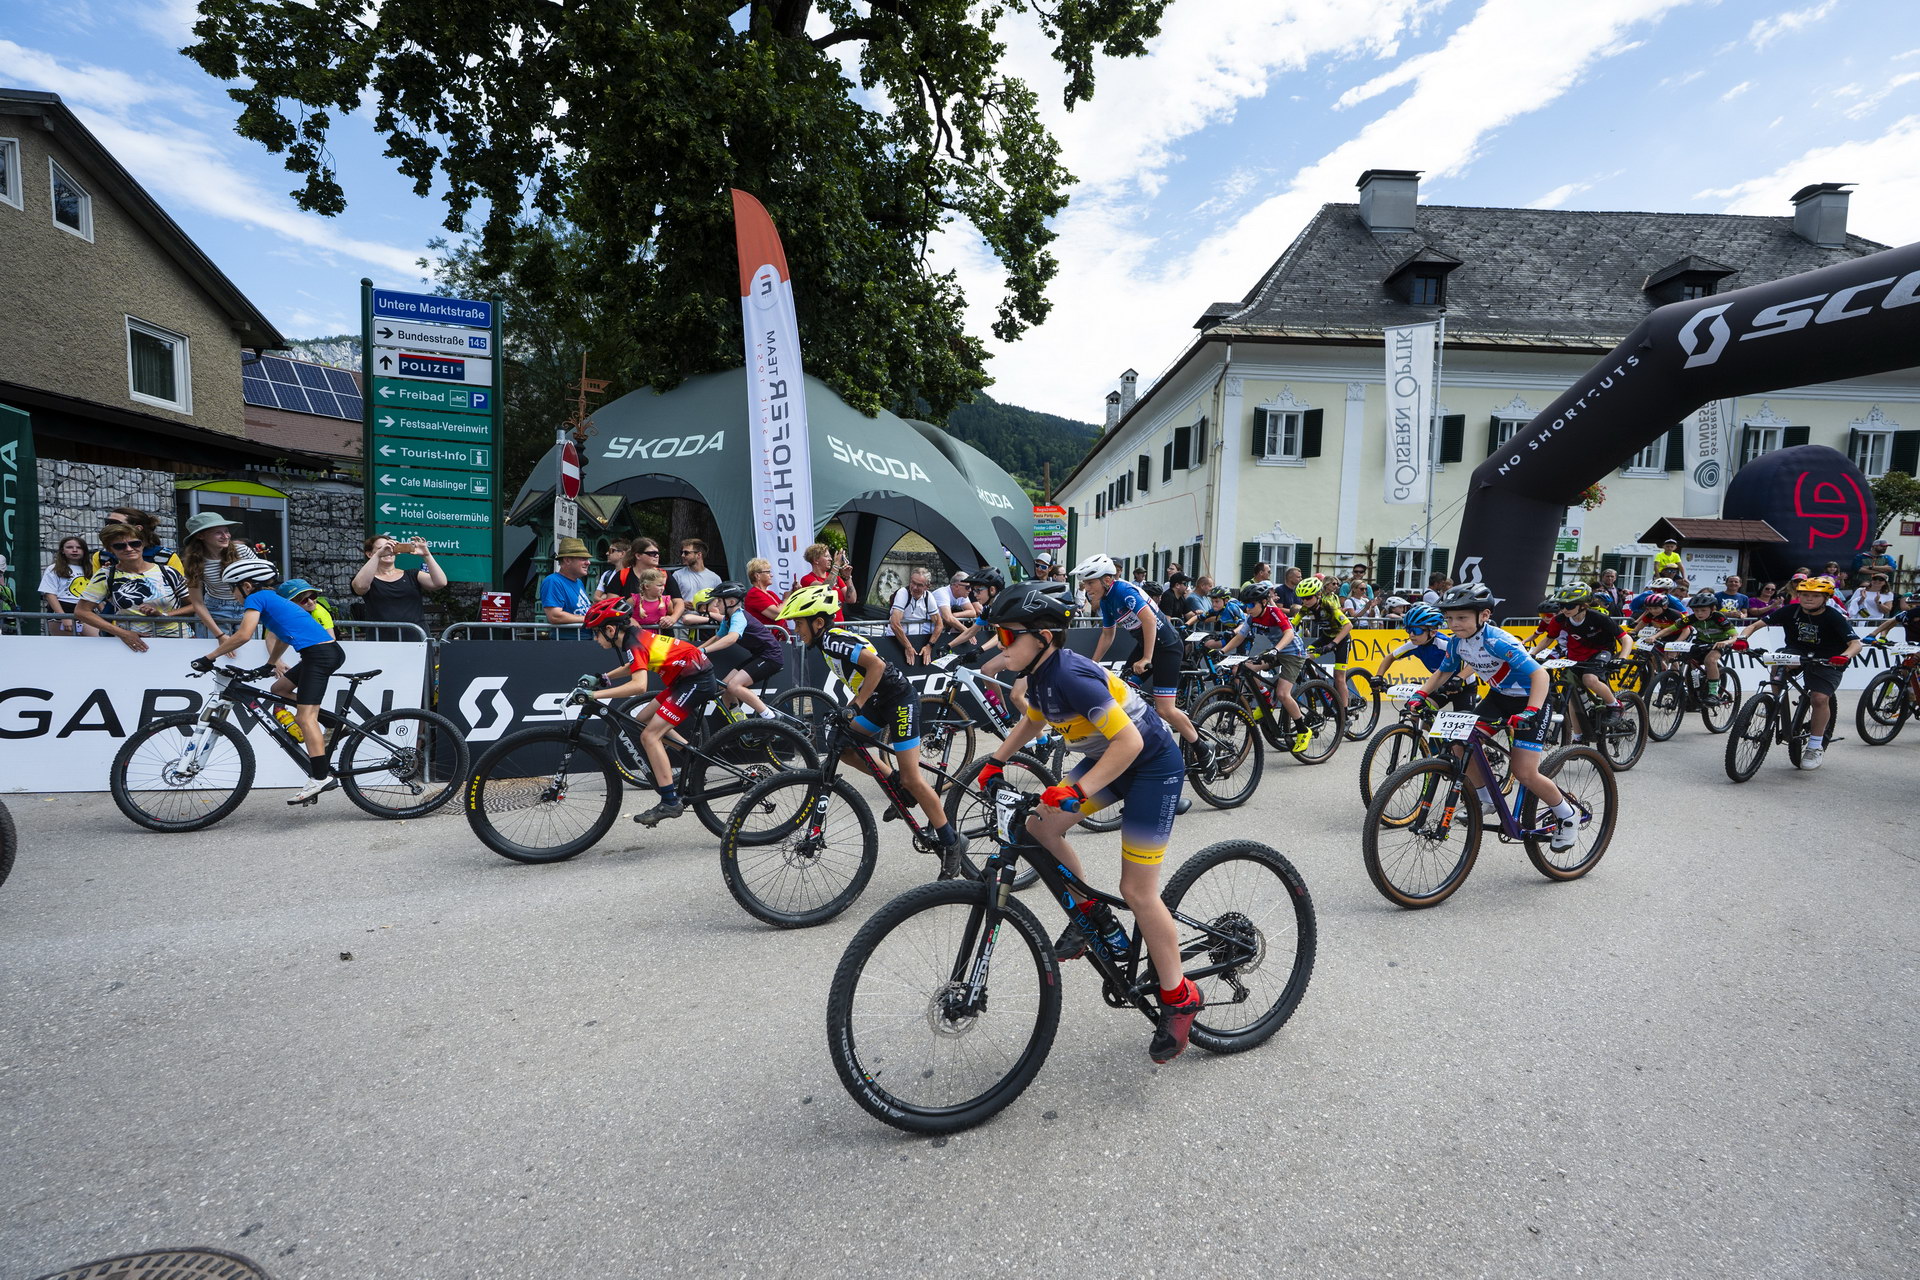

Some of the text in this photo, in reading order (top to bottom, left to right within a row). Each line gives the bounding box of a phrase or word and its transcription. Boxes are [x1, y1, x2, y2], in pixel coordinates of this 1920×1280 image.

[378, 298, 485, 320] Untere Marktstraße
[398, 330, 487, 349] Bundesstraße 145
[401, 361, 454, 375] POLIZEI
[399, 389, 485, 407] Freibad P
[400, 418, 488, 434] Festsaal-Vereinwirt
[400, 447, 467, 462] Tourist-Info
[1498, 454, 1522, 477] NO
[400, 477, 468, 491] Cafe Maislinger
[400, 508, 490, 523] Hotel Goiserermühle
[660, 705, 681, 722] PERRO
[470, 775, 481, 810] MAXXIS
[841, 1027, 864, 1086] ROCKET
[863, 1087, 889, 1112] RON
